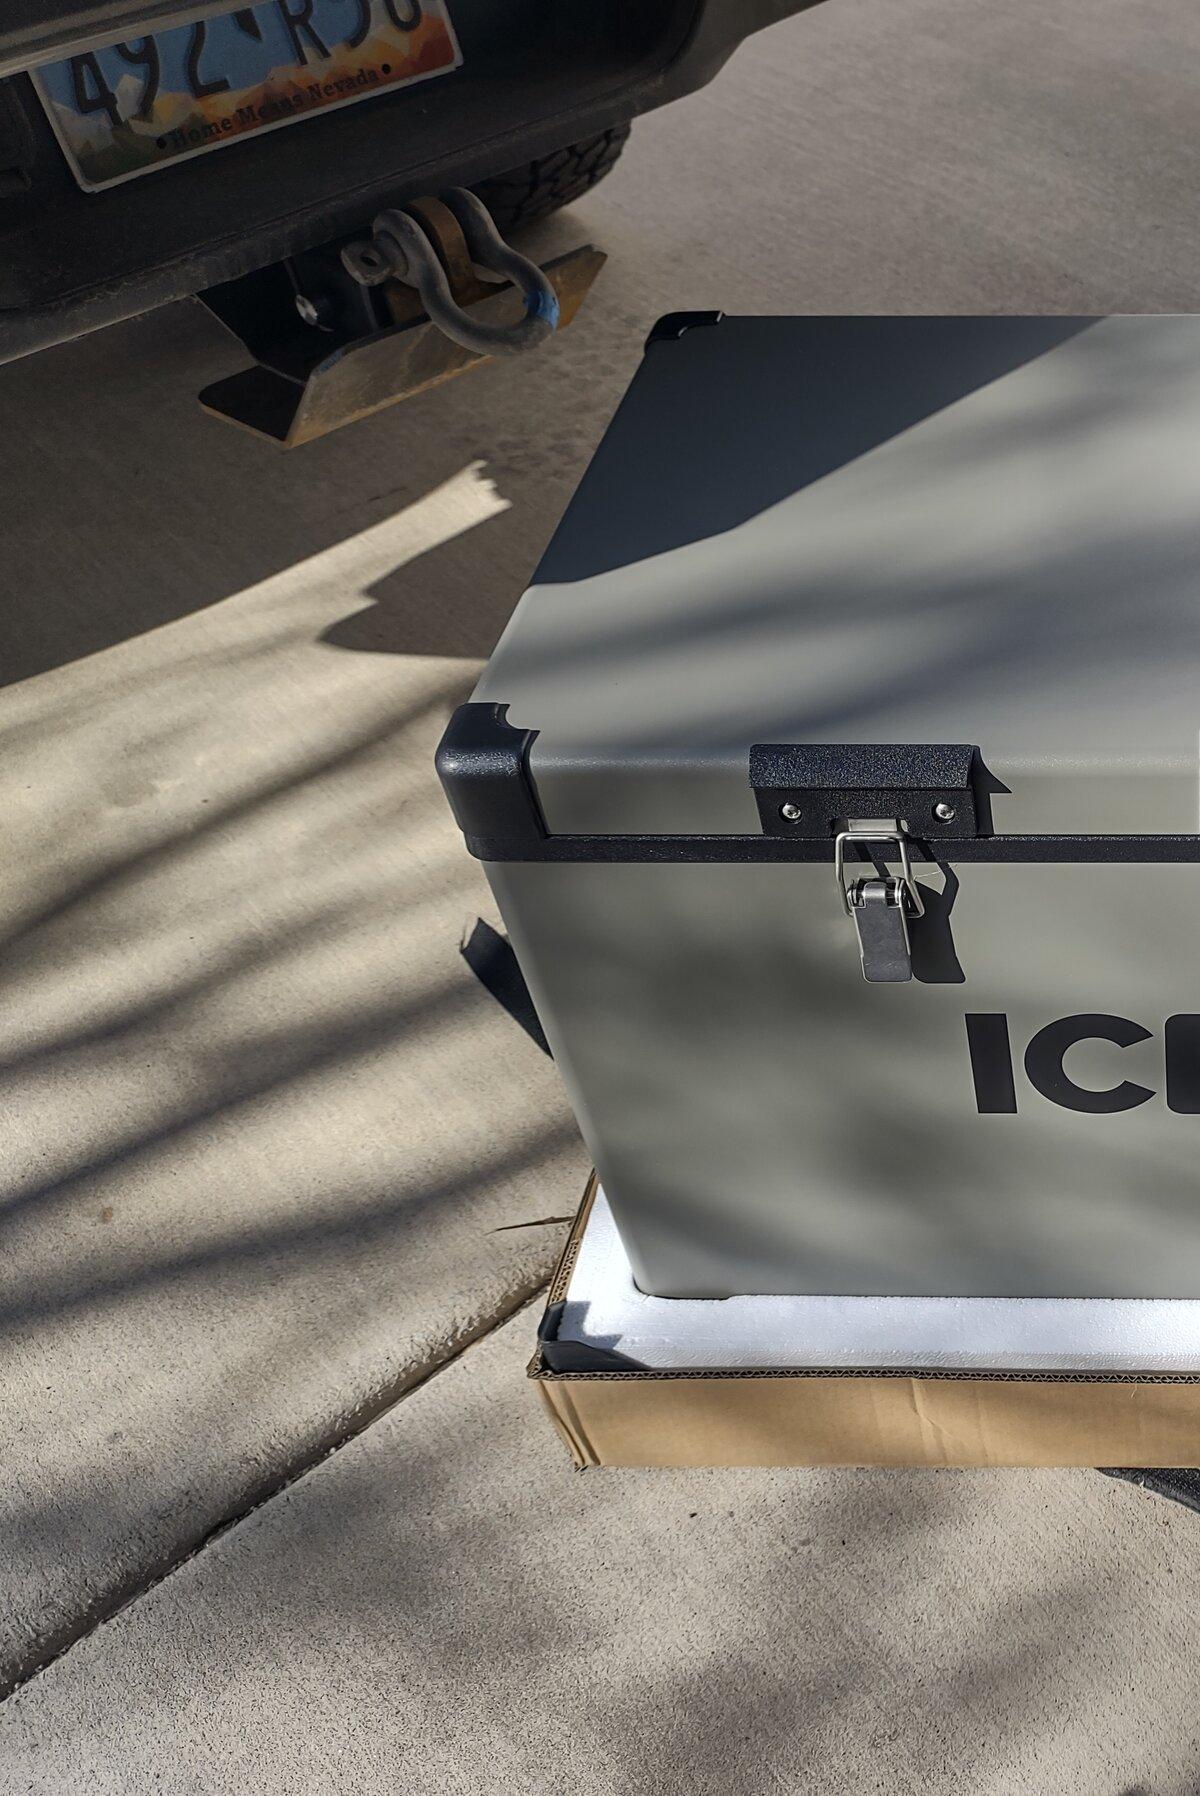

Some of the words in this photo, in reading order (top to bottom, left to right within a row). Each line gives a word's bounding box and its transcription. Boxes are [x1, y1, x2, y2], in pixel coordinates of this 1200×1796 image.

[170, 116, 234, 148] Home
[235, 92, 304, 125] Means
[305, 68, 379, 101] Nevada
